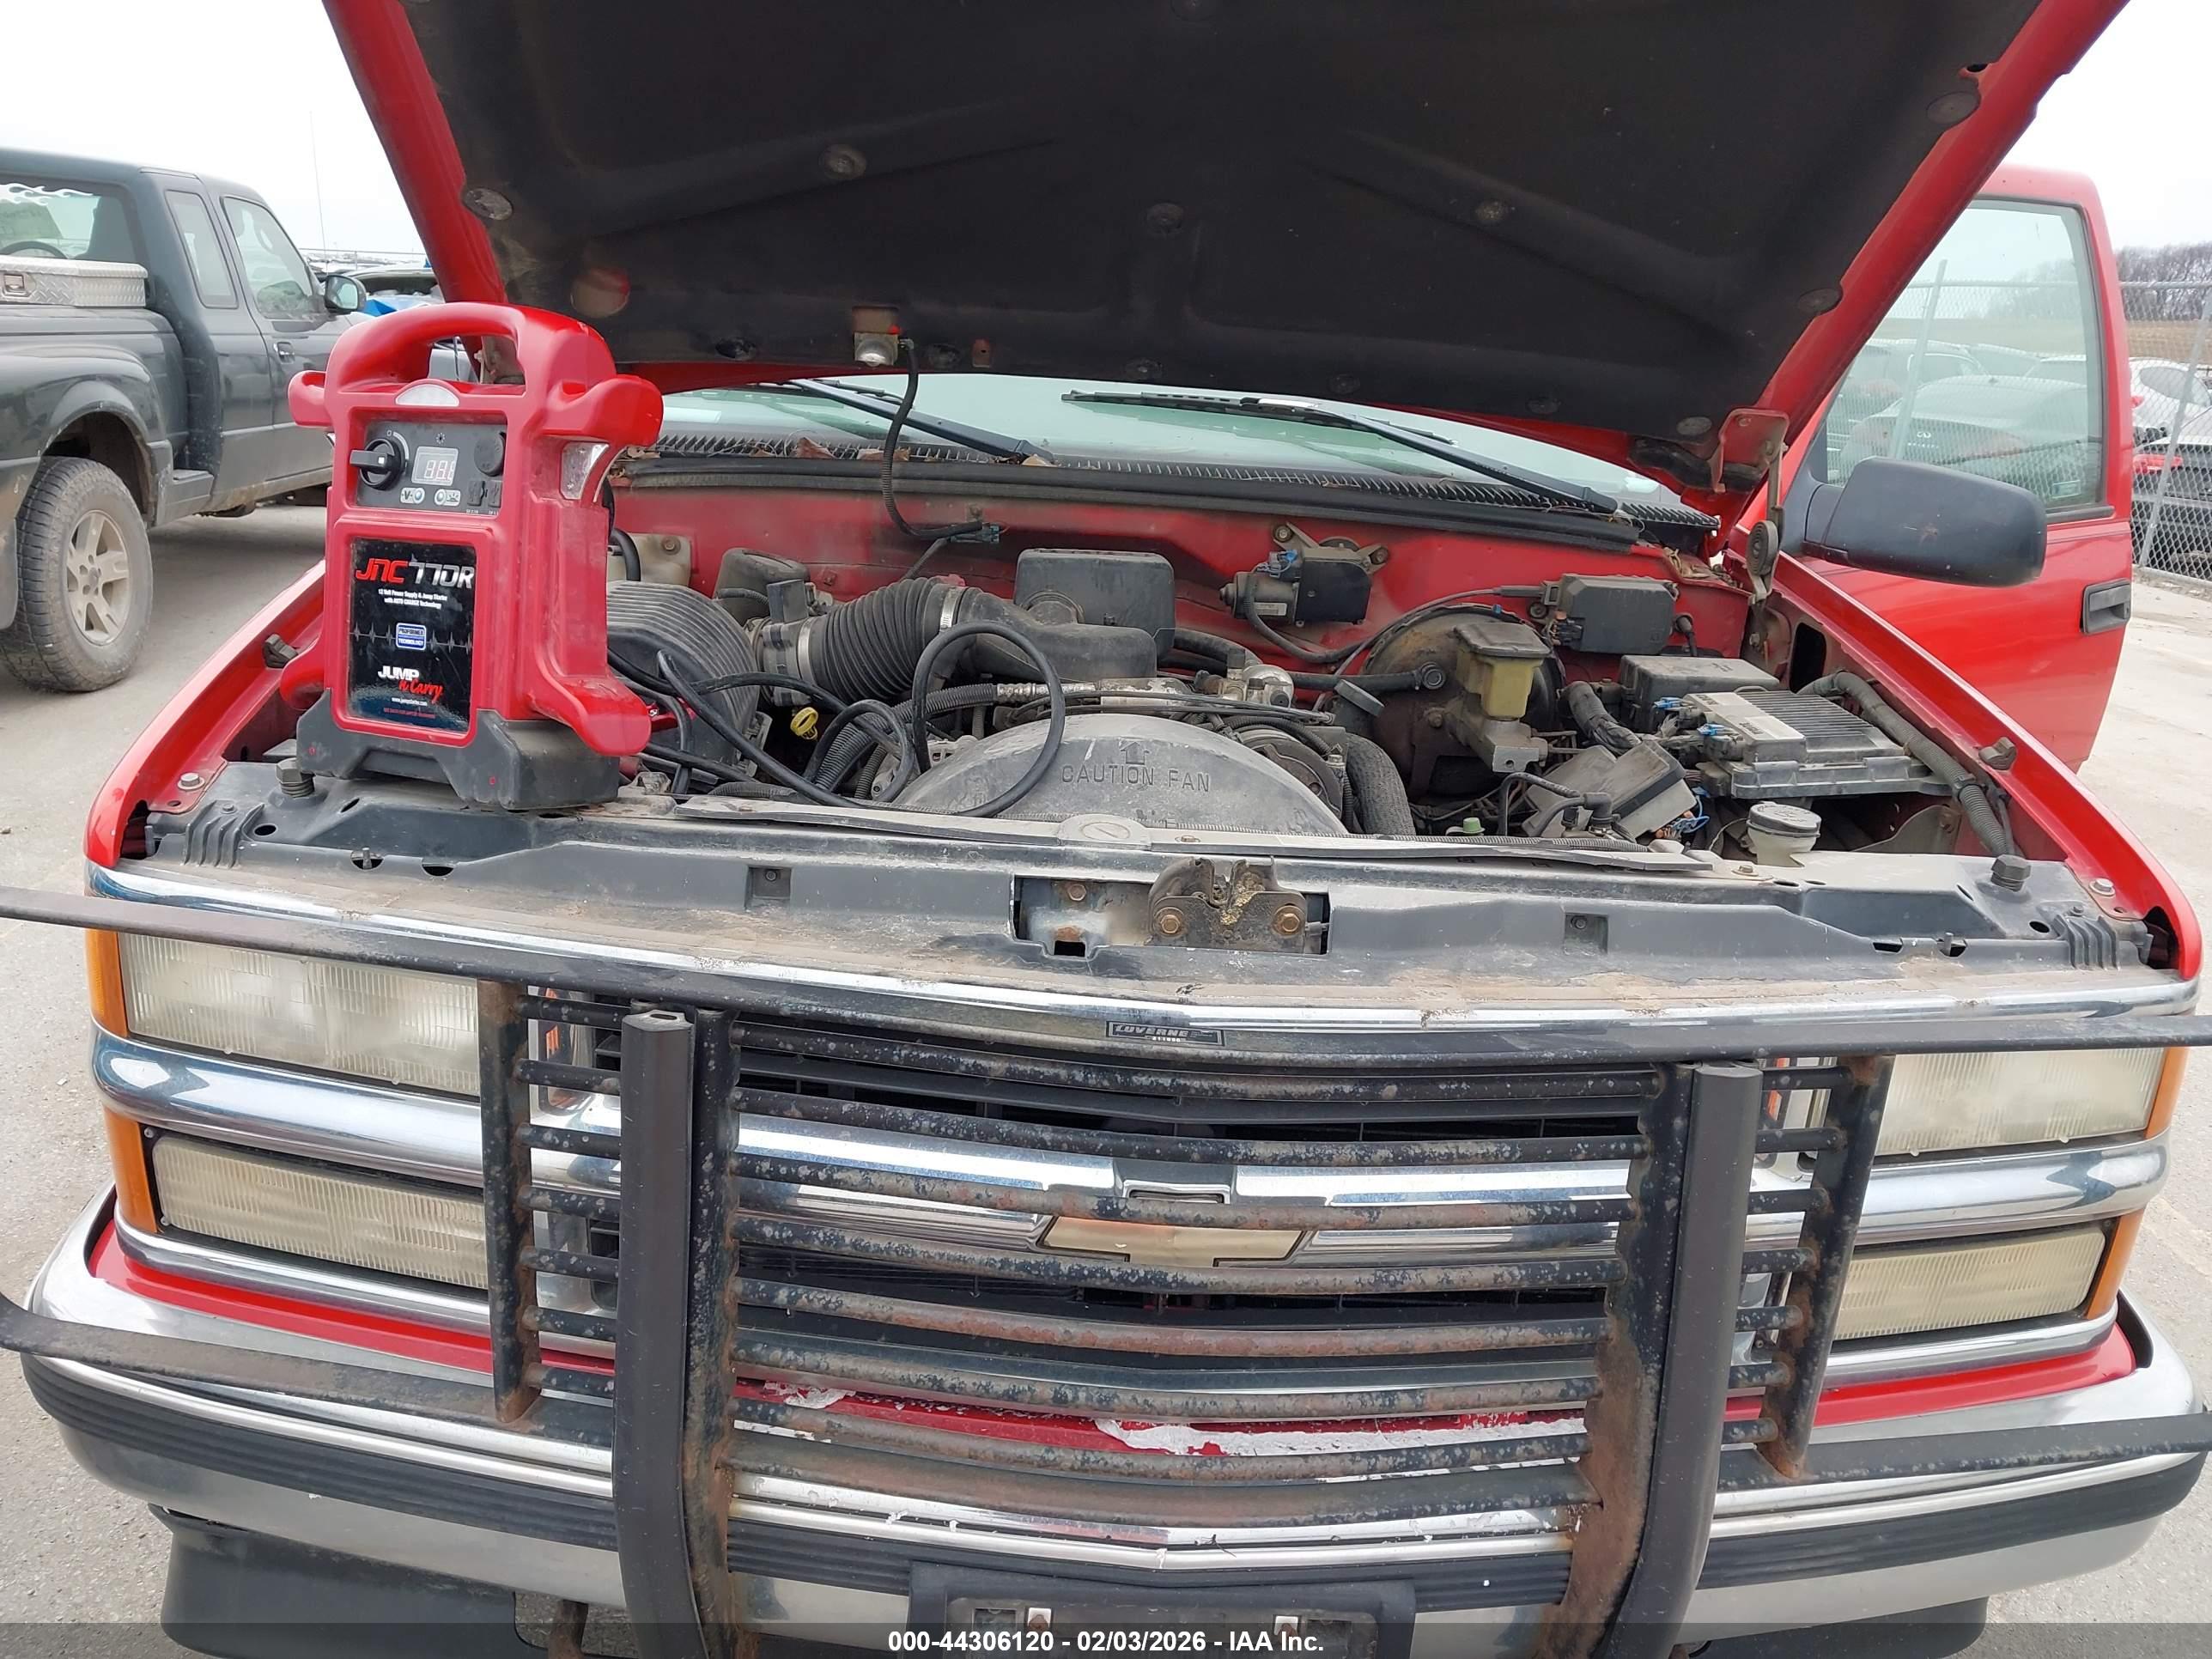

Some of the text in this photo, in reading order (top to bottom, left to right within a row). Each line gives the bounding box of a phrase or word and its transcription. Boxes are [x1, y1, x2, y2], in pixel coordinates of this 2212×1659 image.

[398, 638, 424, 647] TECHNOLOGY
[378, 665, 420, 681] JUMP
[1061, 763, 1211, 793] CAUTION FAN
[1115, 1024, 1189, 1038] LUVERNE
